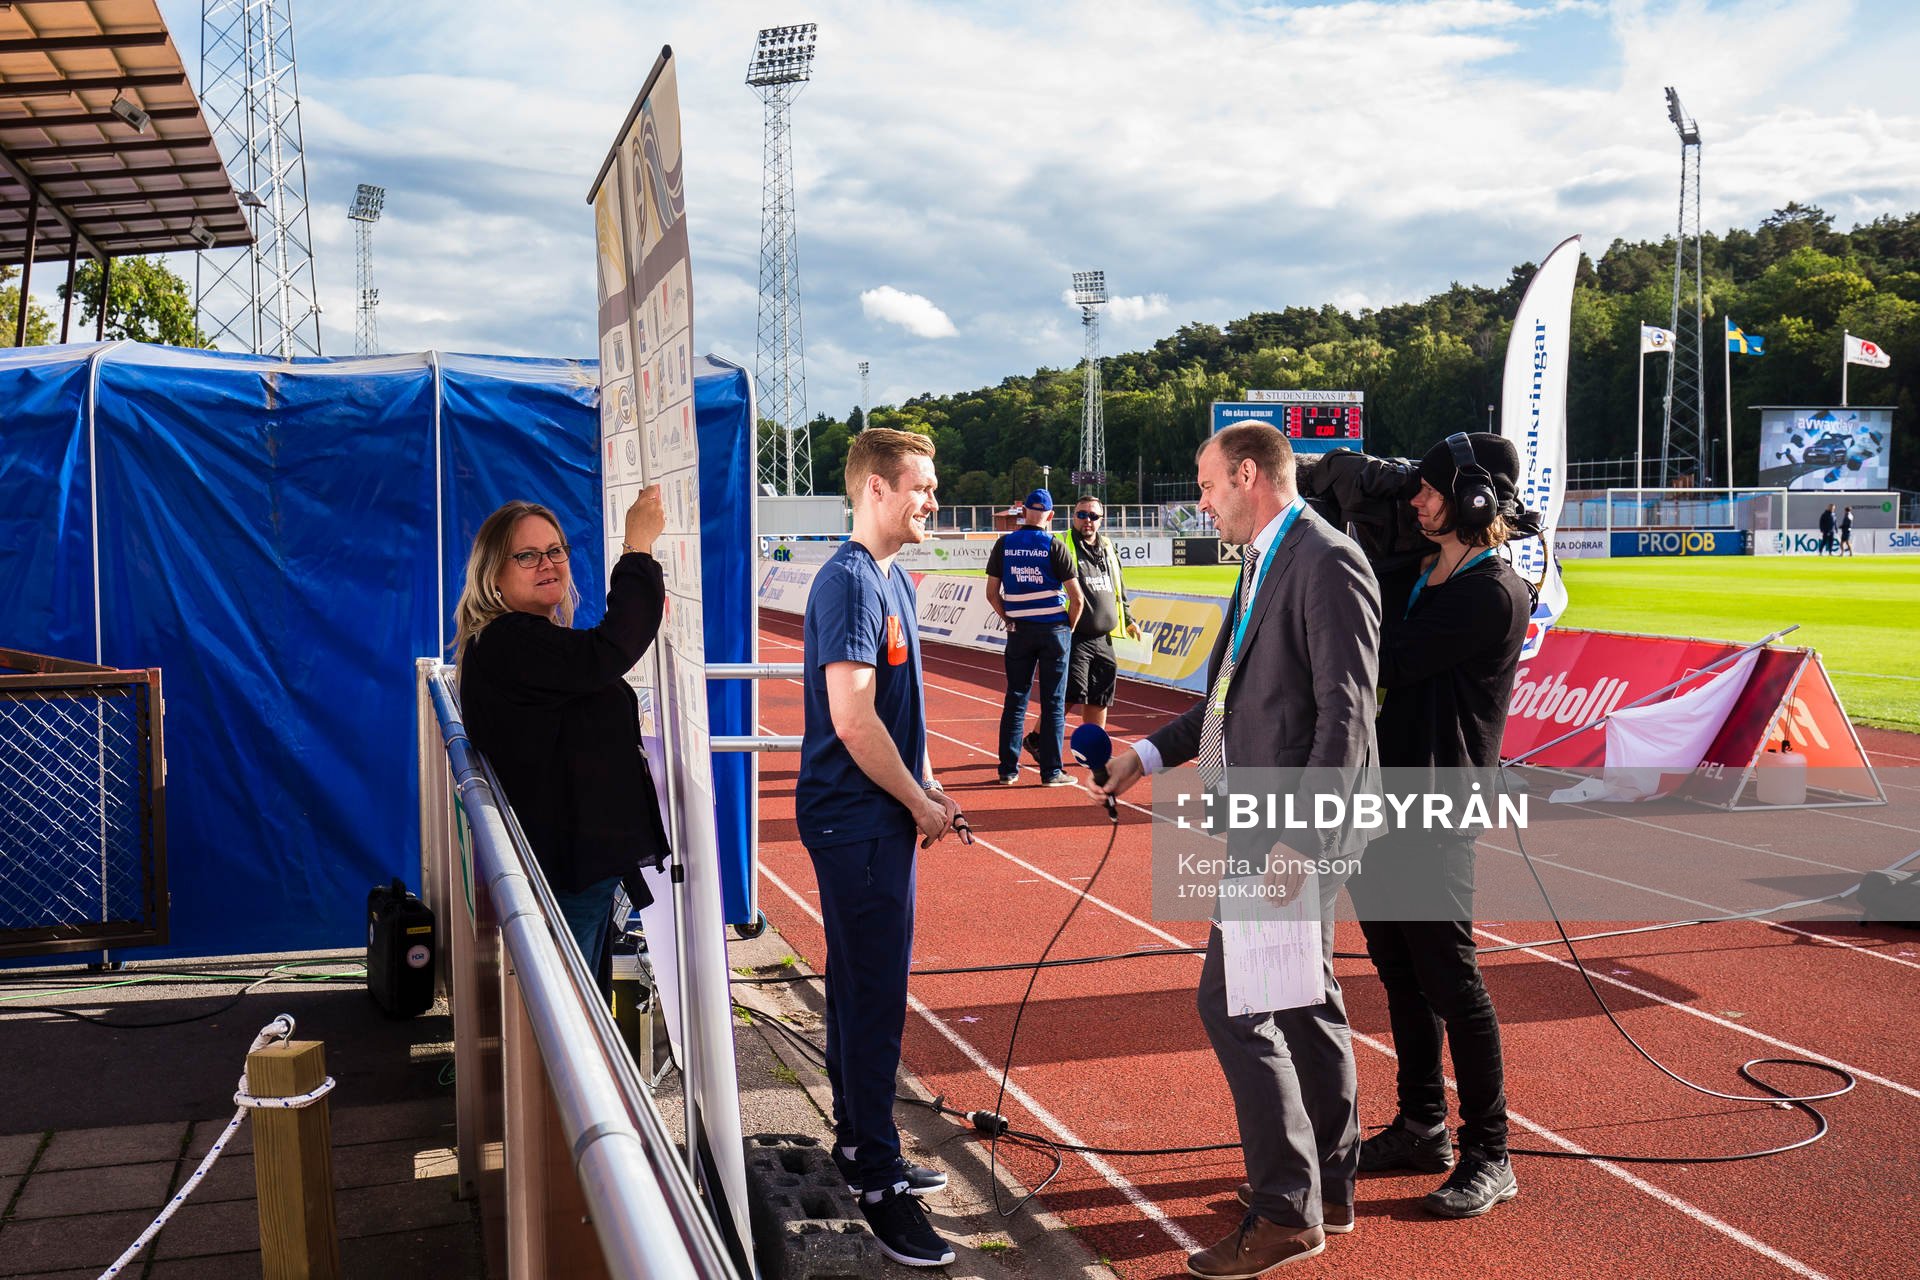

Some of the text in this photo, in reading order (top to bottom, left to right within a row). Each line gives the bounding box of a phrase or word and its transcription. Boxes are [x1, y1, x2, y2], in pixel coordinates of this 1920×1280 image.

[1266, 391, 1346, 401] STUDENTERNAS IP
[1638, 533, 1716, 555] PROJOB
